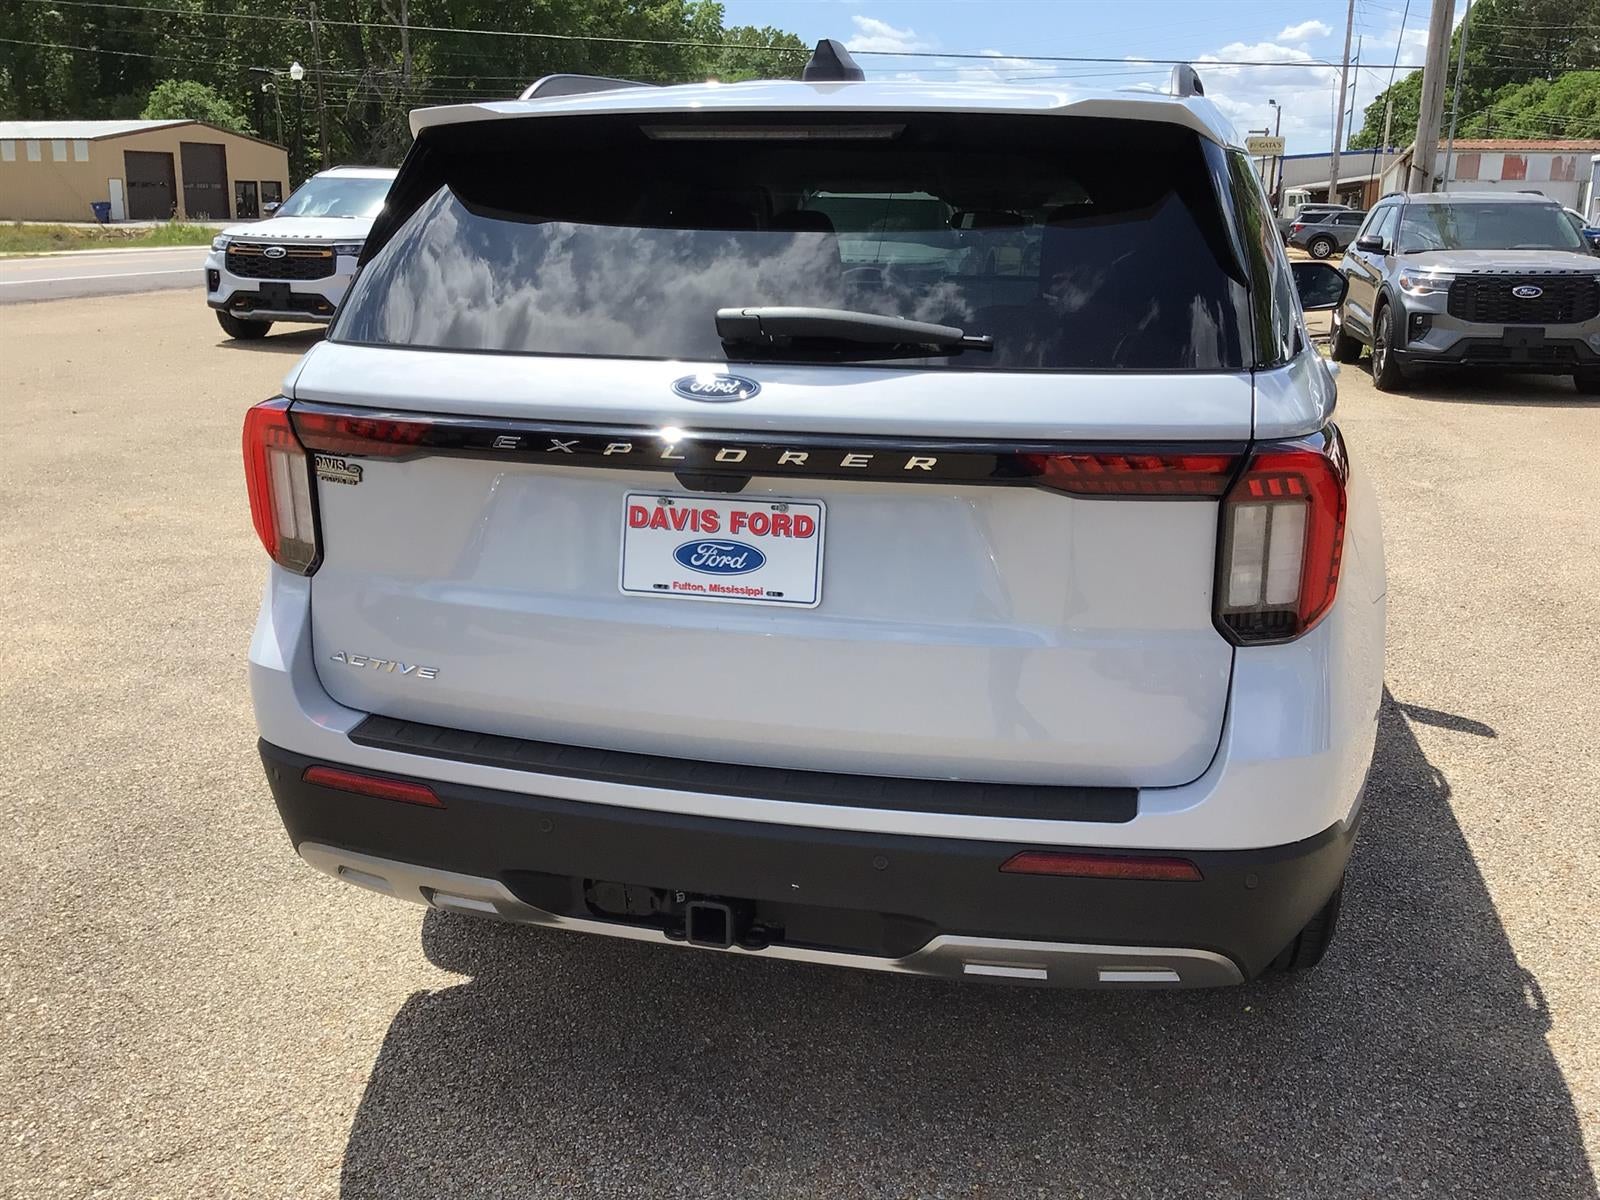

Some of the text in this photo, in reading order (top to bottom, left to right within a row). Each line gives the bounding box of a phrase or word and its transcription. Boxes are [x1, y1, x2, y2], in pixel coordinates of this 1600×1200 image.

[690, 378, 740, 394] Ford
[492, 435, 938, 472] EXPLORER
[629, 505, 815, 538] DAVIS FORD
[690, 543, 749, 569] Ford
[672, 581, 764, 597] Fulton, Mississippi
[330, 650, 440, 679] ACTIVE
